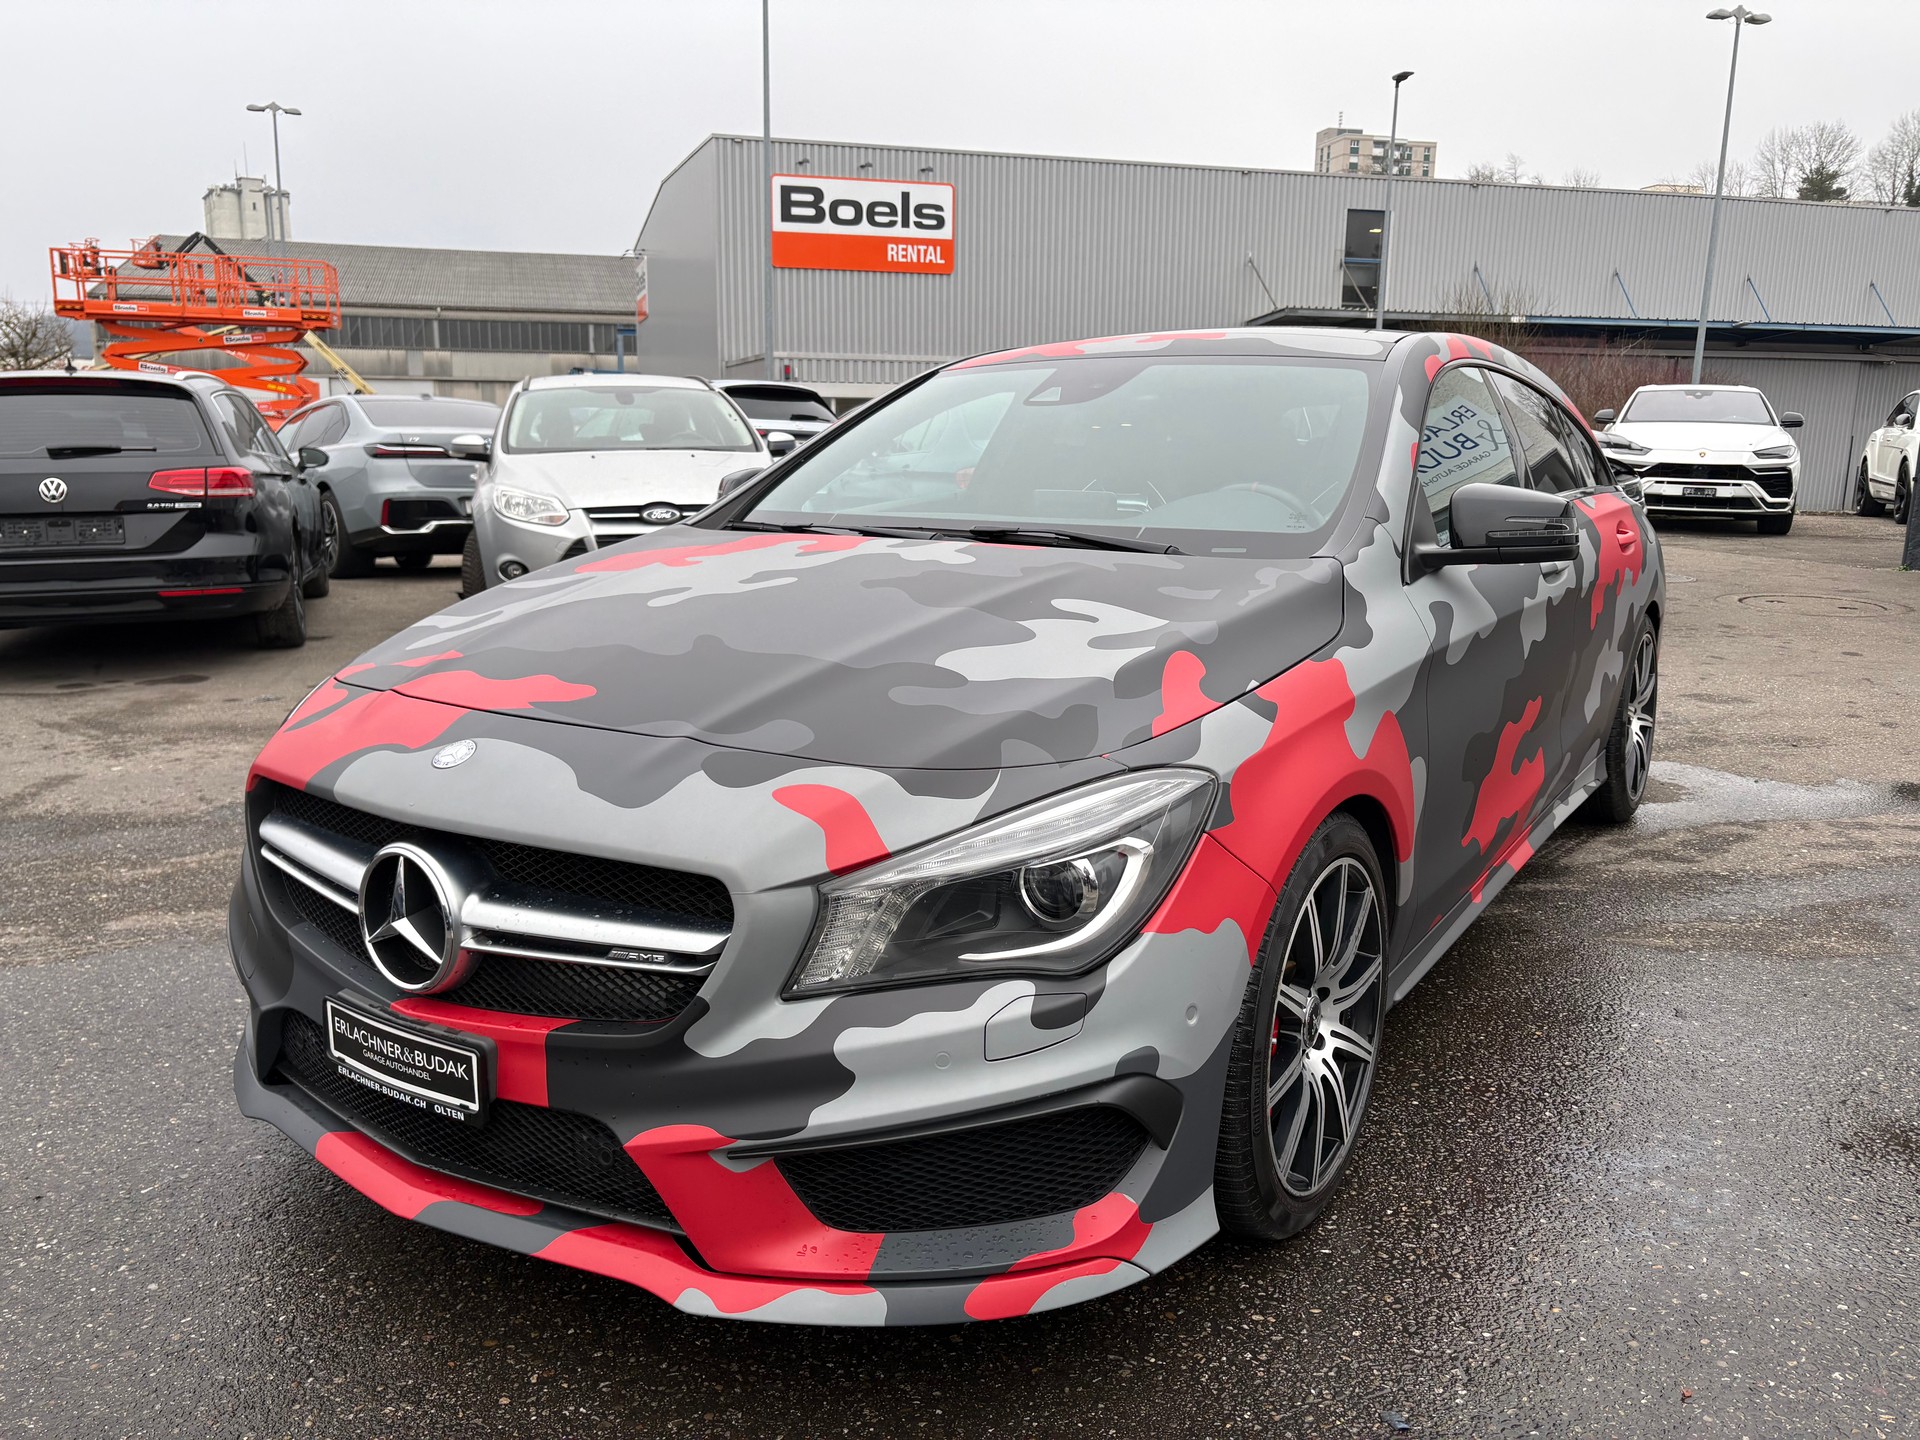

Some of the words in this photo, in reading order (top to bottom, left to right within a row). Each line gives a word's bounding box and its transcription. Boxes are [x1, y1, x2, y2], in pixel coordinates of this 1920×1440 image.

[780, 184, 946, 231] Boels
[887, 243, 945, 264] RENTAL
[334, 1016, 469, 1081] ERLACHNER&BUDAK
[362, 1048, 386, 1066] GARAGE
[385, 1060, 432, 1081] AUTOHANDEL
[338, 1065, 427, 1109] ERLACHNER-BUDAK.CH
[434, 1104, 465, 1121] OLTEN
